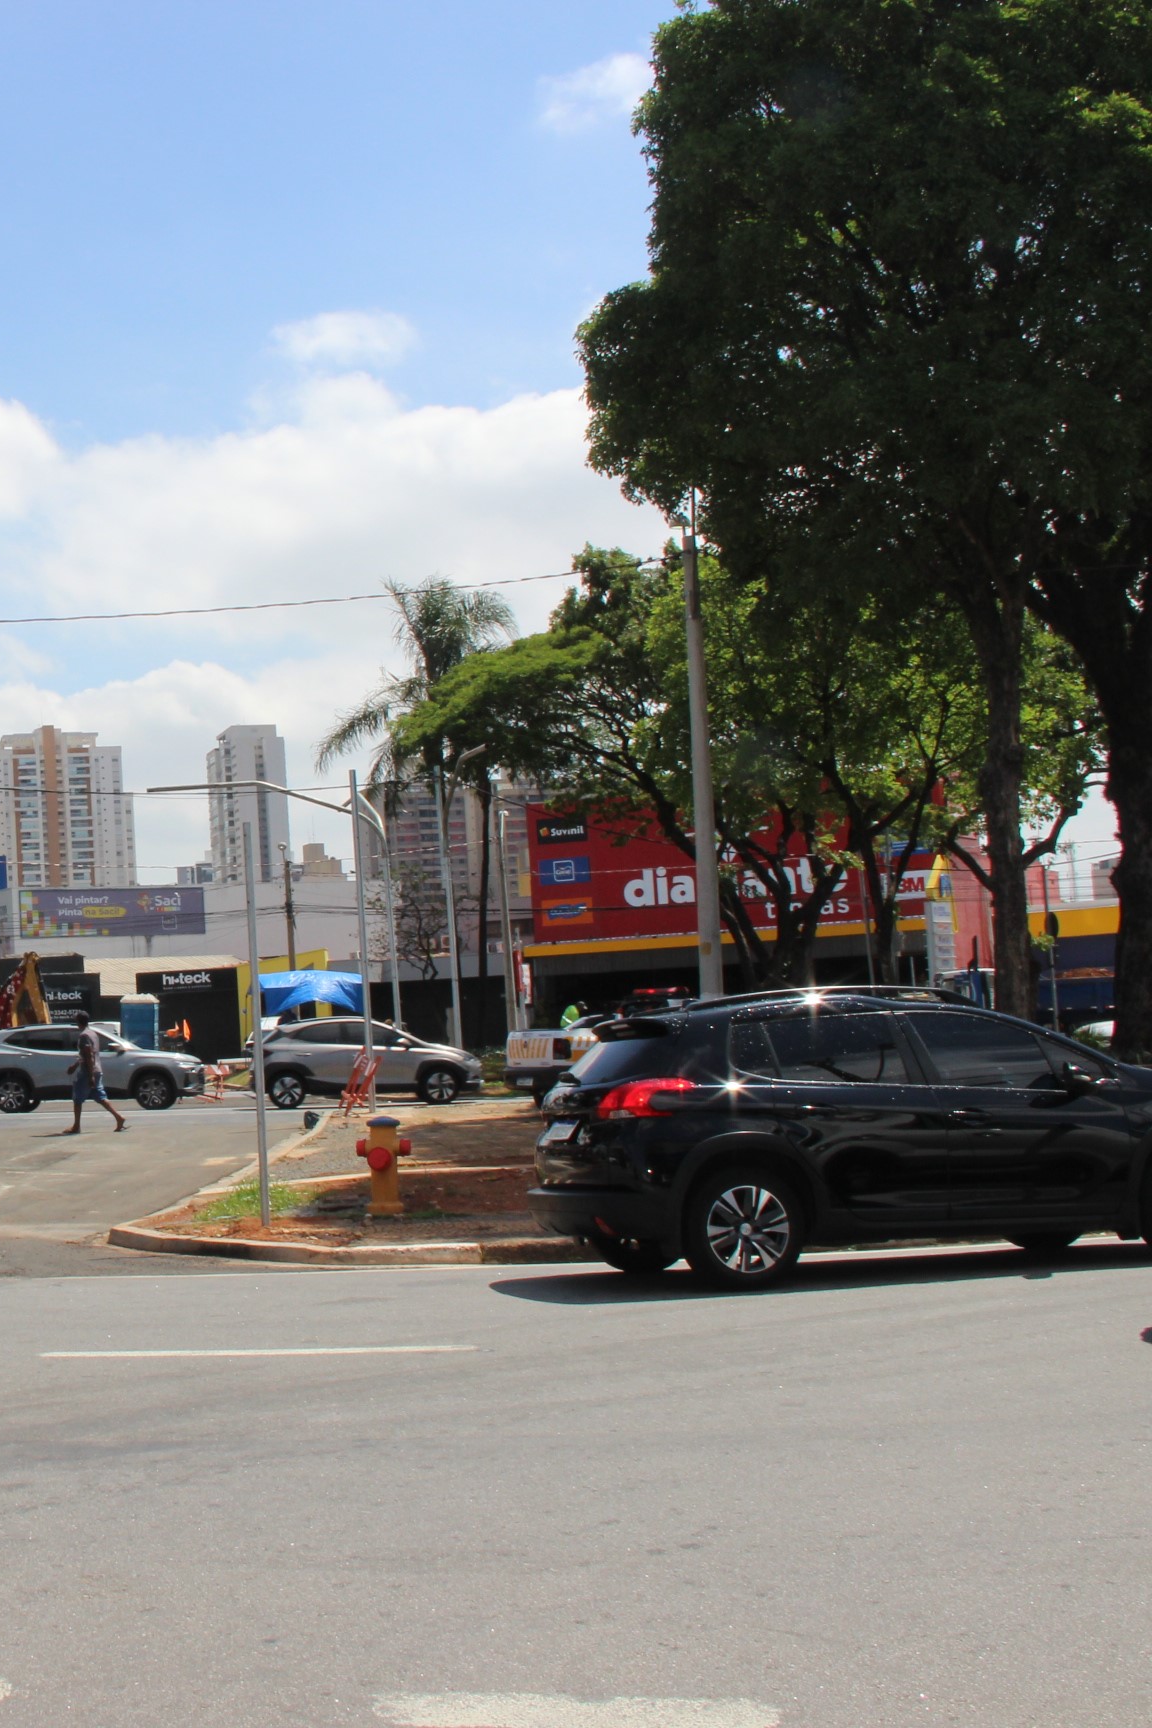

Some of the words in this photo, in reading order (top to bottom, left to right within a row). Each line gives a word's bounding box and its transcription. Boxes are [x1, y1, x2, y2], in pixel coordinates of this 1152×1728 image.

[550, 825, 584, 837] Suvinil
[898, 876, 925, 893] 3M
[57, 896, 73, 904] Vai
[75, 896, 109, 906] pintar?
[154, 893, 181, 907] Saci
[58, 908, 83, 916] Pinta
